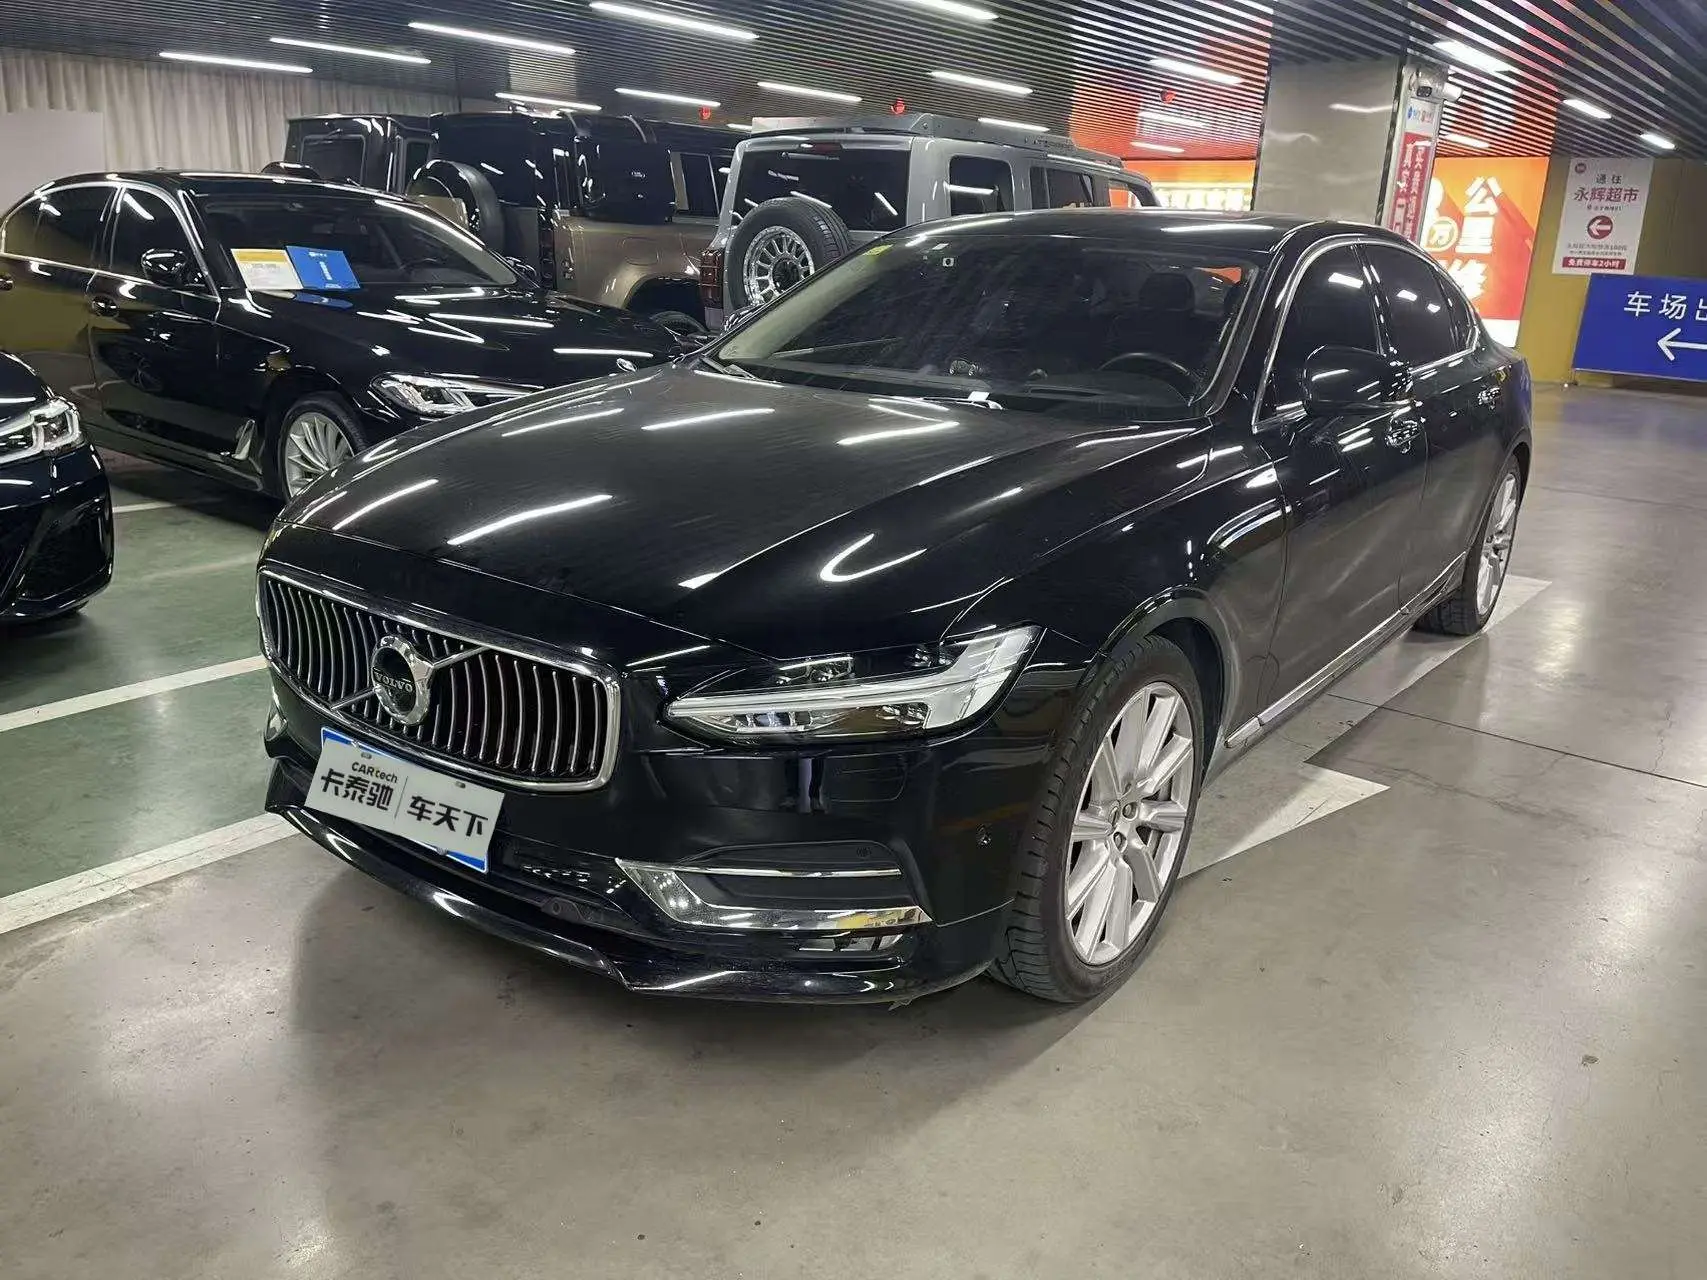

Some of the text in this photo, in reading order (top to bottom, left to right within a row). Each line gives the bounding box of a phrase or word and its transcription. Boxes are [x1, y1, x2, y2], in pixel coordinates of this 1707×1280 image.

[1574, 186, 1640, 203] 永辉超市
[373, 670, 413, 693] VOLVO
[351, 760, 399, 785] CARtech
[320, 768, 395, 812] 卡泰驰
[406, 794, 489, 838] 车天下
